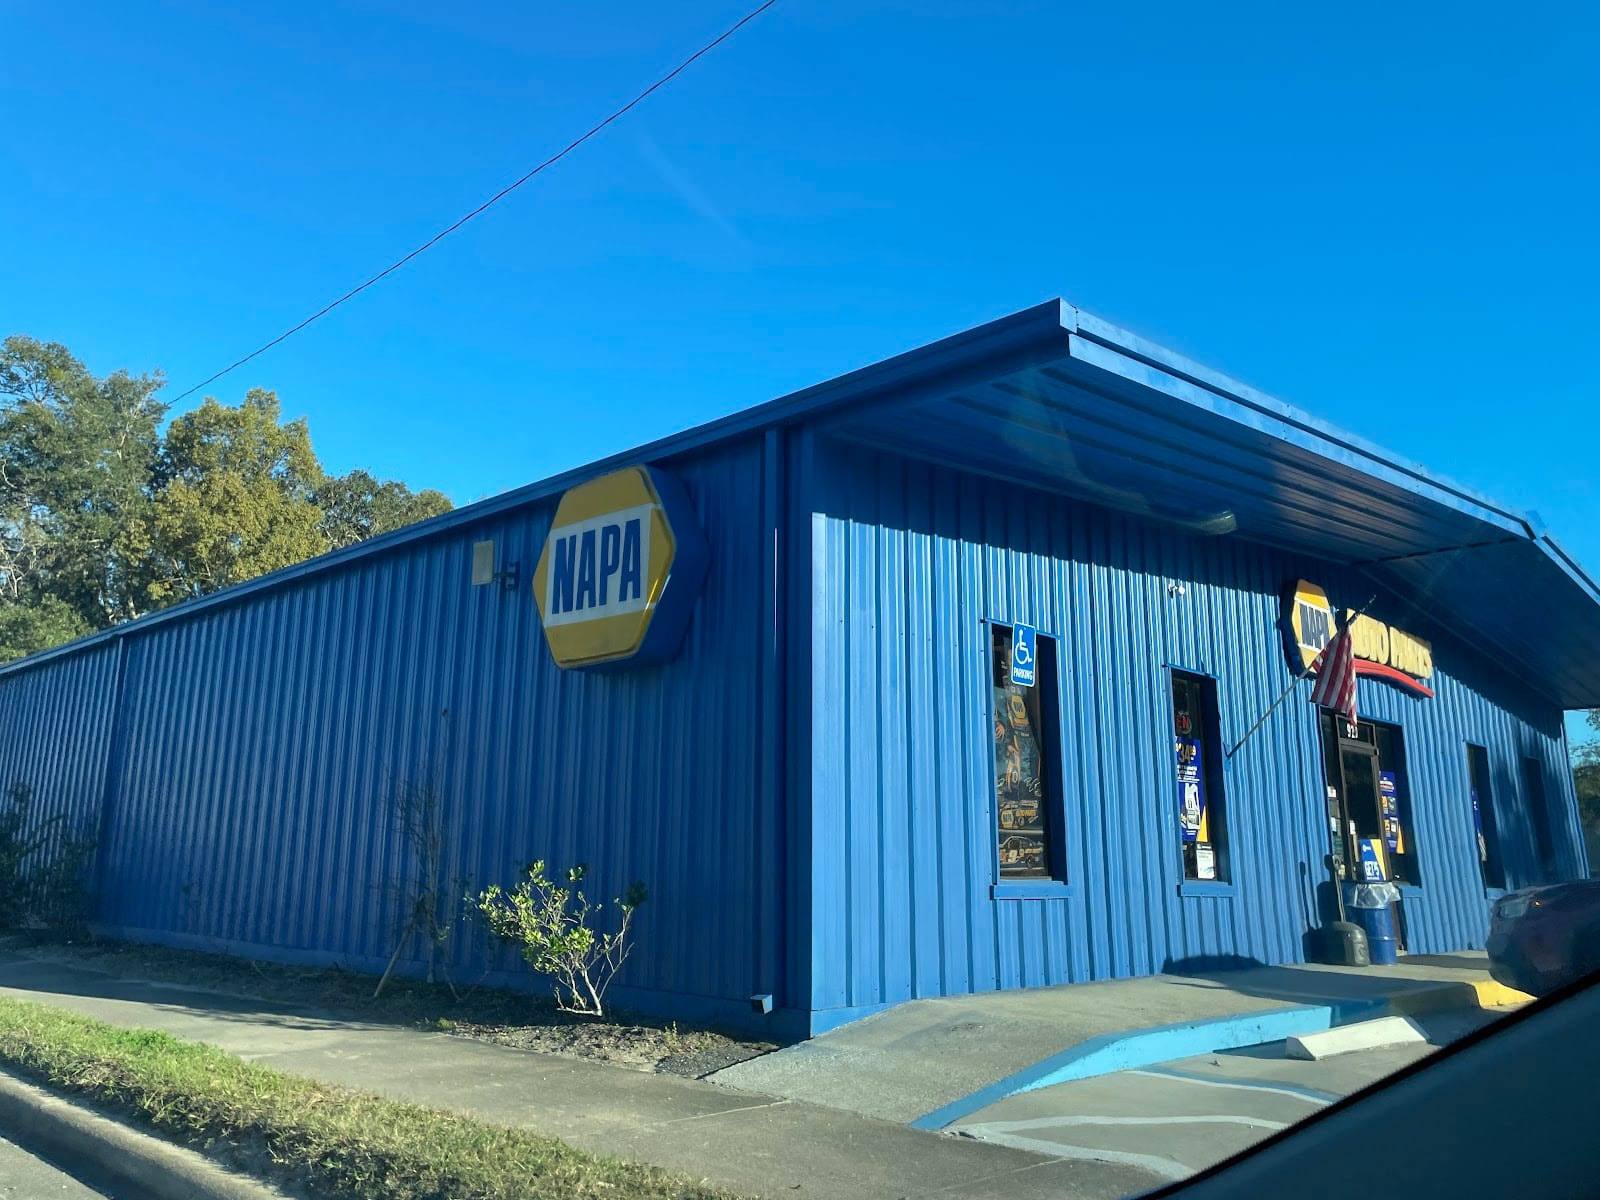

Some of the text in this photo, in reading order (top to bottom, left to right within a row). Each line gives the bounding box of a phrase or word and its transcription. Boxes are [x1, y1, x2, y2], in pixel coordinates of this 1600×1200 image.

[552, 518, 640, 615] NAPA
[1300, 602, 1331, 650] NAPA
[1013, 666, 1033, 681] PARKING
[1390, 626, 1433, 679] PARTS
